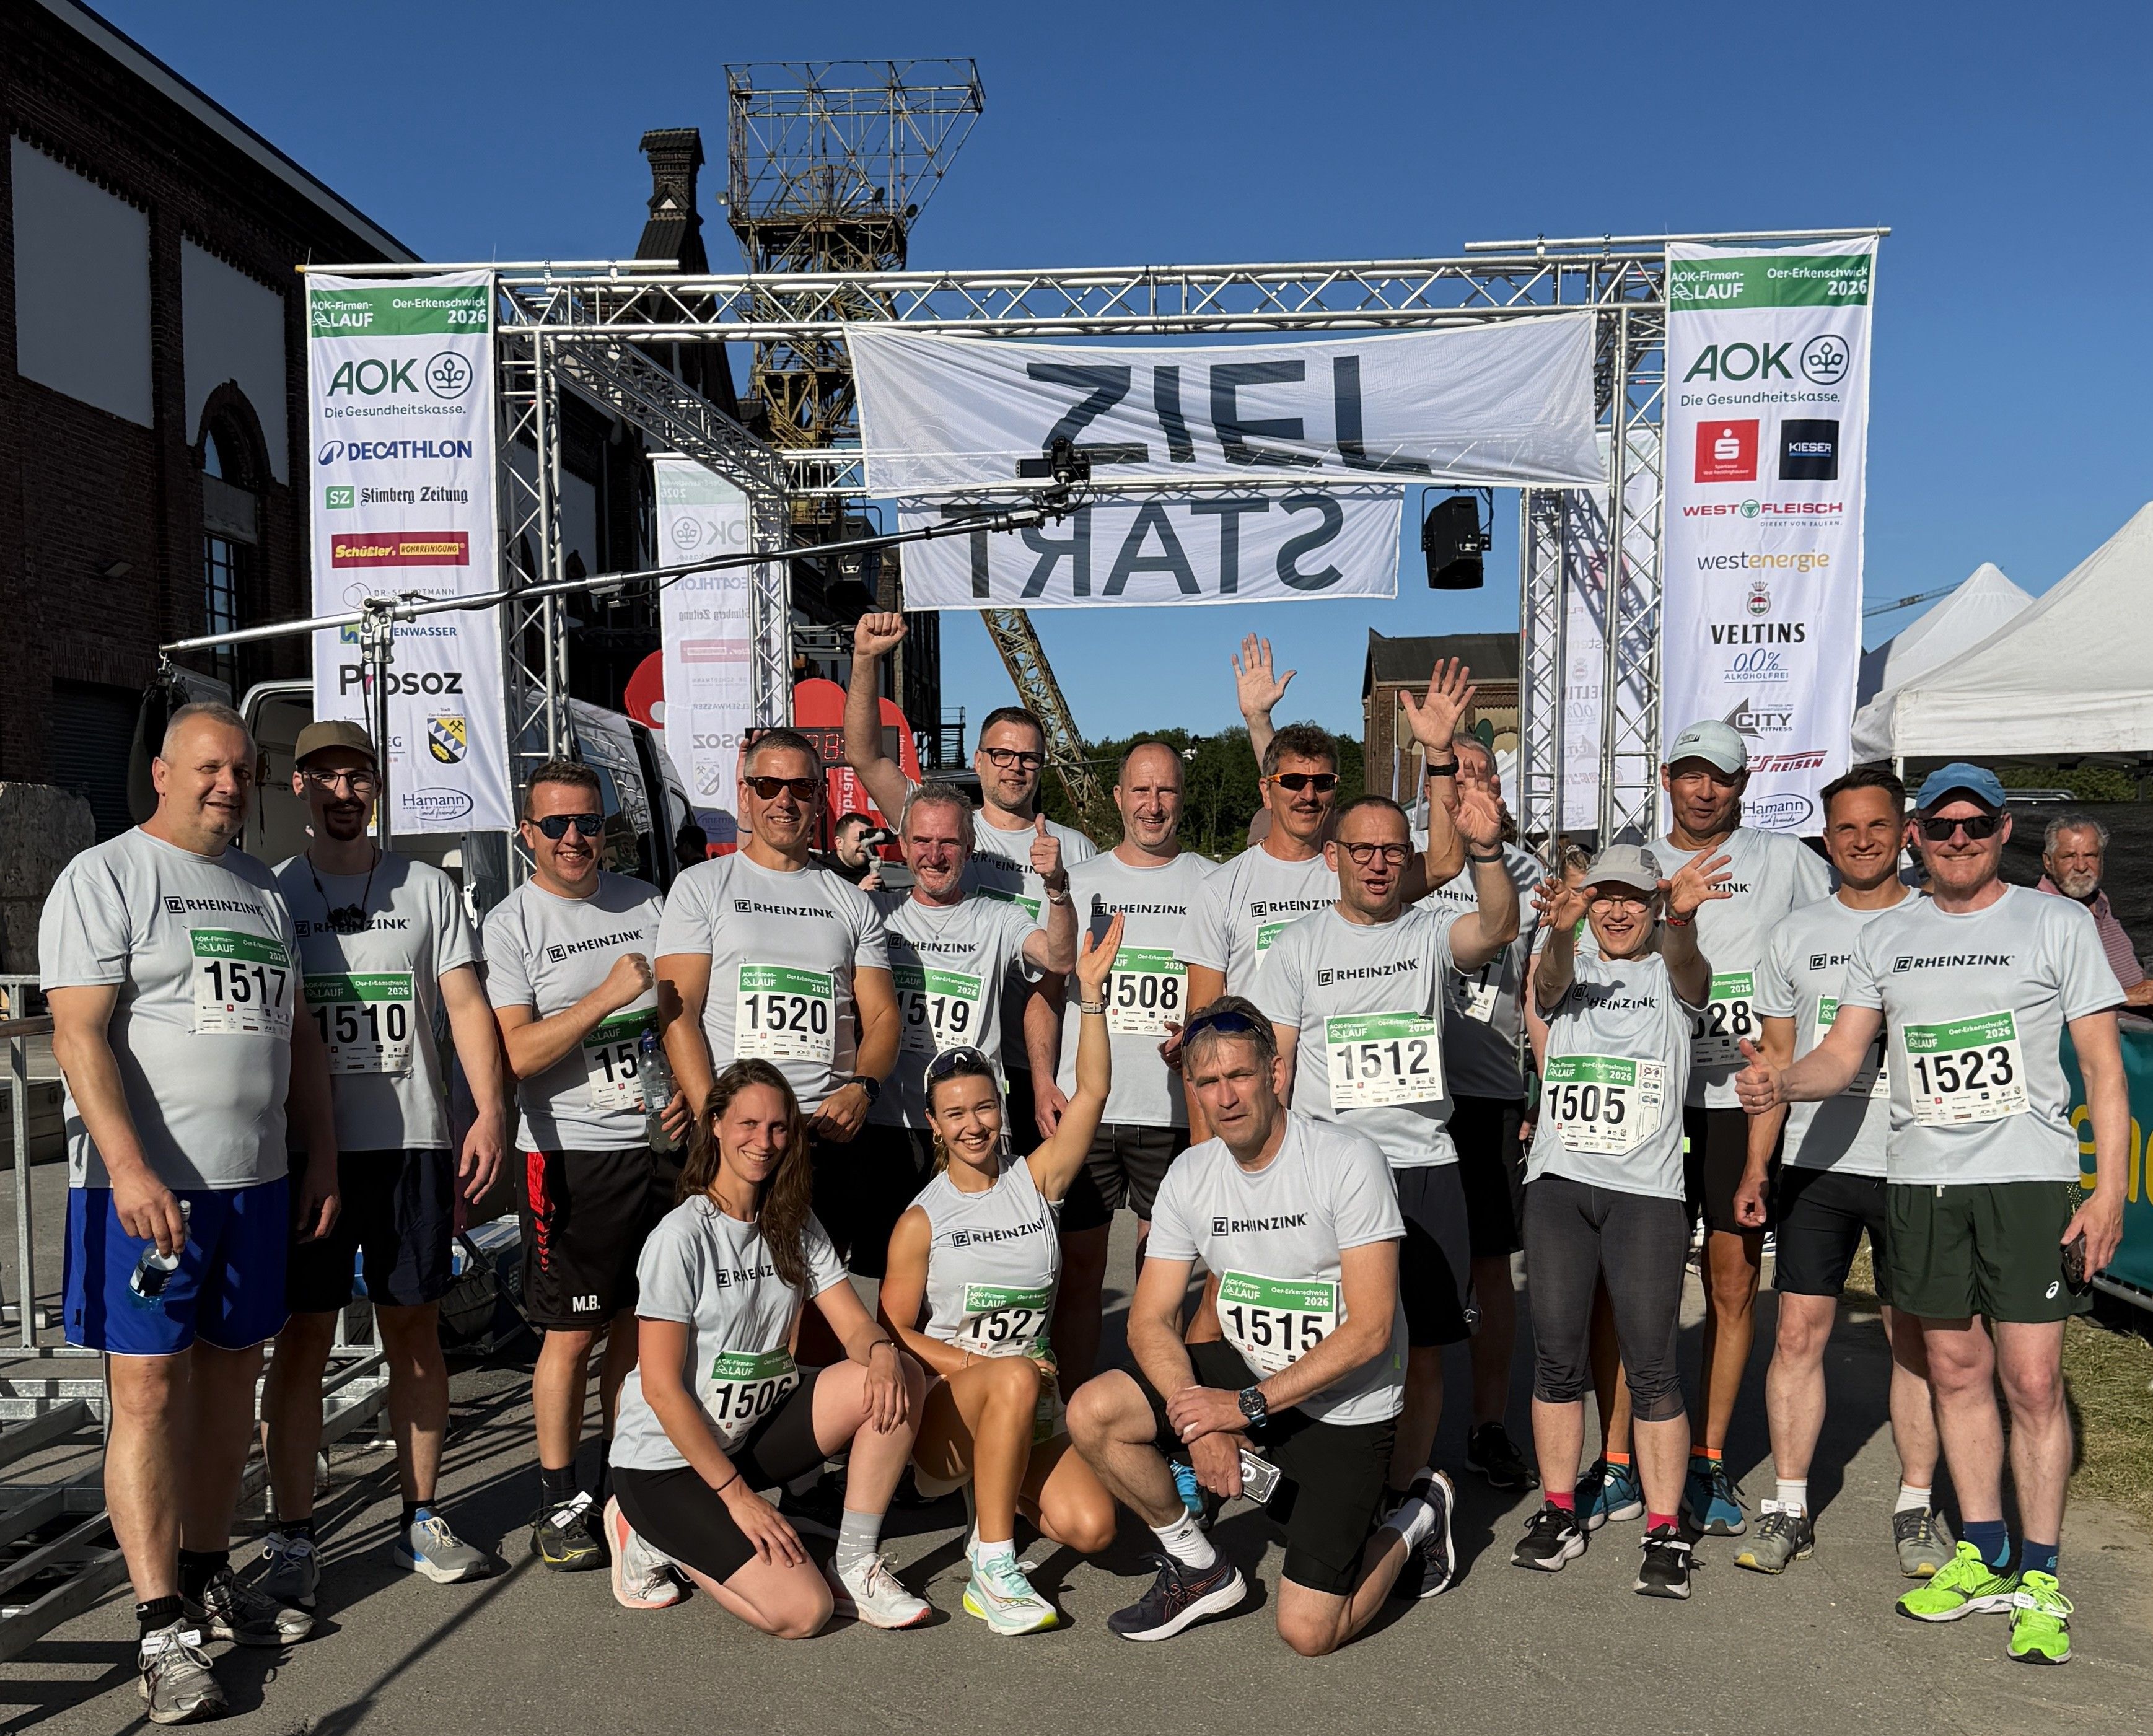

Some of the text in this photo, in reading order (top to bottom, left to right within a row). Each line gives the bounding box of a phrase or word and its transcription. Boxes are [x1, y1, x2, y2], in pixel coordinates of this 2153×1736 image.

[1671, 271, 1744, 282] AOK-Firmen-
[1767, 267, 1867, 279] Oer-Erkenschwick
[1695, 283, 1743, 299] LAUF
[1828, 279, 1867, 296] 2026
[311, 300, 374, 310] AOK-Firmen-
[392, 297, 486, 309] Oer-Erkenschwick
[331, 312, 374, 327] LAUF
[447, 310, 486, 325] 2026
[1683, 342, 1794, 383] AOK
[327, 358, 419, 397] AOK
[1680, 392, 1840, 406] Die Gesundheitskasse.
[325, 404, 466, 419] Die Gesundheitskasse.
[1025, 355, 1432, 476] ZIEL
[348, 440, 472, 461] DECATHLON
[1789, 442, 1831, 453] KIESER
[330, 491, 350, 505] SZ
[361, 486, 468, 506] Stimberg Zeitung
[401, 545, 457, 553] ROHRREINIGUNG
[1698, 550, 1830, 572] westenergie
[394, 627, 457, 636] ENWASSER
[1711, 623, 1805, 644] VELTINS
[1724, 672, 1789, 680] ALKOHOLFREI
[1738, 712, 1792, 727] CITY
[1769, 758, 1824, 773] REISEN
[403, 794, 465, 806] Hamann
[1742, 800, 1804, 814] Hamann
[186, 899, 263, 917] RHEINZINK
[754, 903, 835, 918] RHEINZINK
[1110, 904, 1187, 915] RHEINZINK
[1269, 899, 1341, 912] RHEINZIN
[209, 943, 235, 953] LAUF
[568, 930, 643, 954] RHEINZINK
[903, 941, 976, 953] RHEINZINK
[269, 951, 286, 963] 2026
[1914, 955, 2012, 968] RHEINZINK
[1164, 962, 1184, 970] 2026
[1336, 960, 1418, 980] RHEINZINK
[204, 960, 286, 1007] 1517
[812, 984, 830, 994] 2026
[1730, 984, 1752, 993] 2026
[318, 988, 343, 998] LAUF
[387, 987, 408, 996] 2026
[957, 986, 976, 996] 2026
[1588, 994, 1657, 1009] HEINZINK
[745, 994, 827, 1035] 1520
[1692, 1000, 1752, 1041] 28
[311, 1004, 406, 1044] 1510
[1343, 1028, 1368, 1037] LAUF
[1985, 1027, 2010, 1040] 2026
[1917, 1038, 1938, 1048] LAUF
[595, 1042, 642, 1082] 15
[1336, 1040, 1429, 1081] 1512
[1609, 1071, 1633, 1081] 2026
[1914, 1046, 2014, 1095] 1523
[1547, 1085, 1626, 1124] 1505
[973, 1218, 1046, 1243] RHEINZIN
[1235, 1290, 1260, 1299] LAUF
[572, 1295, 601, 1312] M.B.
[980, 1299, 1006, 1308] LAUF
[1304, 1297, 1329, 1307] 2026
[1227, 1305, 1323, 1352] 1515
[729, 1366, 754, 1376] LAUF
